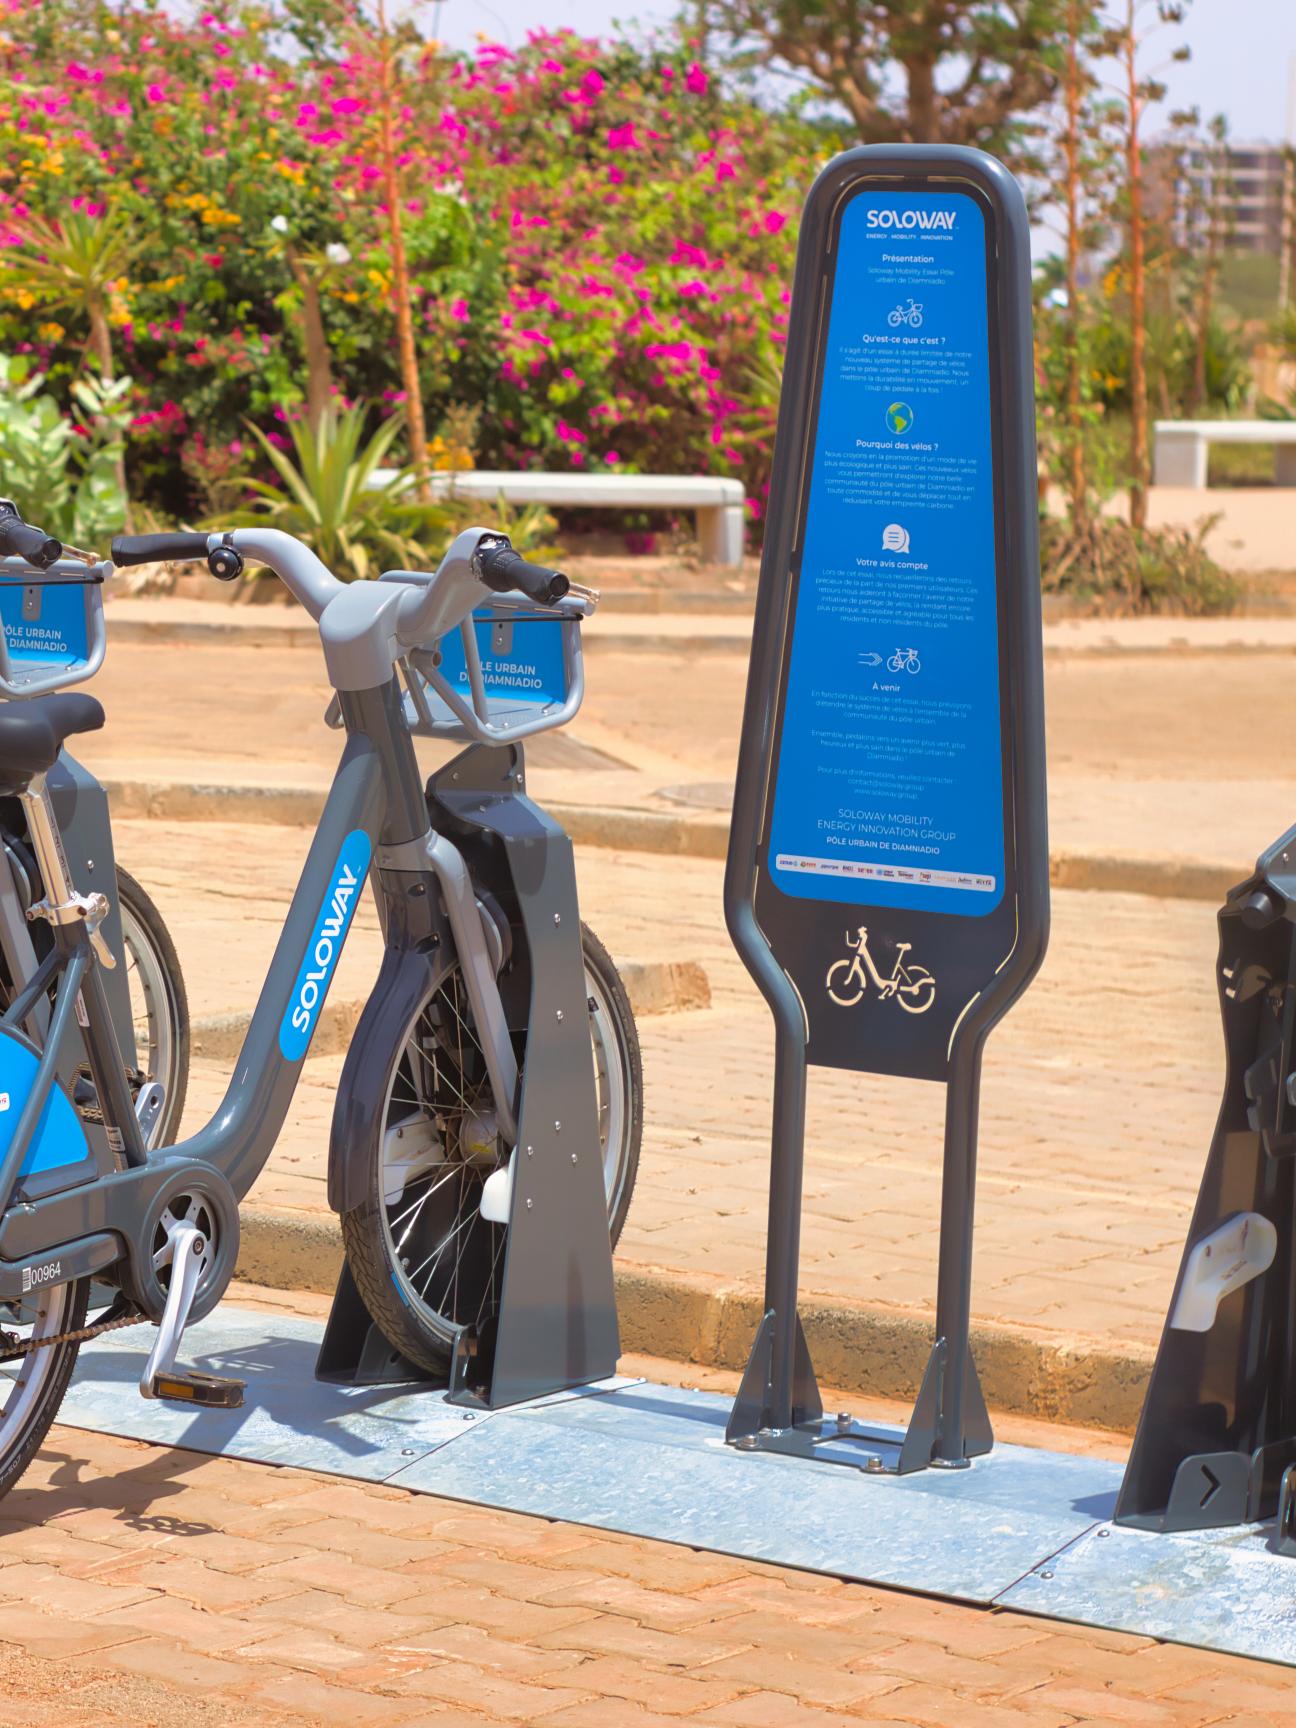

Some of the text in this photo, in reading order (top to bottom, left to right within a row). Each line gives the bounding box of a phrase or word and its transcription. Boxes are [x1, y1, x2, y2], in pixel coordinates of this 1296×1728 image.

[866, 210, 956, 229] SOLOWAY
[882, 254, 933, 262] Présentation
[862, 334, 900, 344] Qu'est-ce
[920, 336, 938, 344] c'est
[856, 439, 892, 450] Pourquoi
[911, 442, 931, 450] vélos
[856, 558, 877, 566] Votre
[897, 561, 928, 571] compte
[26, 628, 62, 640] URBAIN
[10, 638, 68, 652] DIAMNIADIO
[495, 663, 536, 676] URBAIN
[872, 681, 900, 691] À venir
[838, 809, 933, 825] SOLOWAY MOBILITY
[817, 819, 955, 840] ENERGY INNOVATION GROUP
[826, 835, 846, 844] PÔLE
[848, 839, 877, 848] URBAIN
[891, 843, 939, 854] DIAMNIADIO
[292, 864, 358, 1033] SOLOWAY
[32, 1261, 61, 1285] 00964
